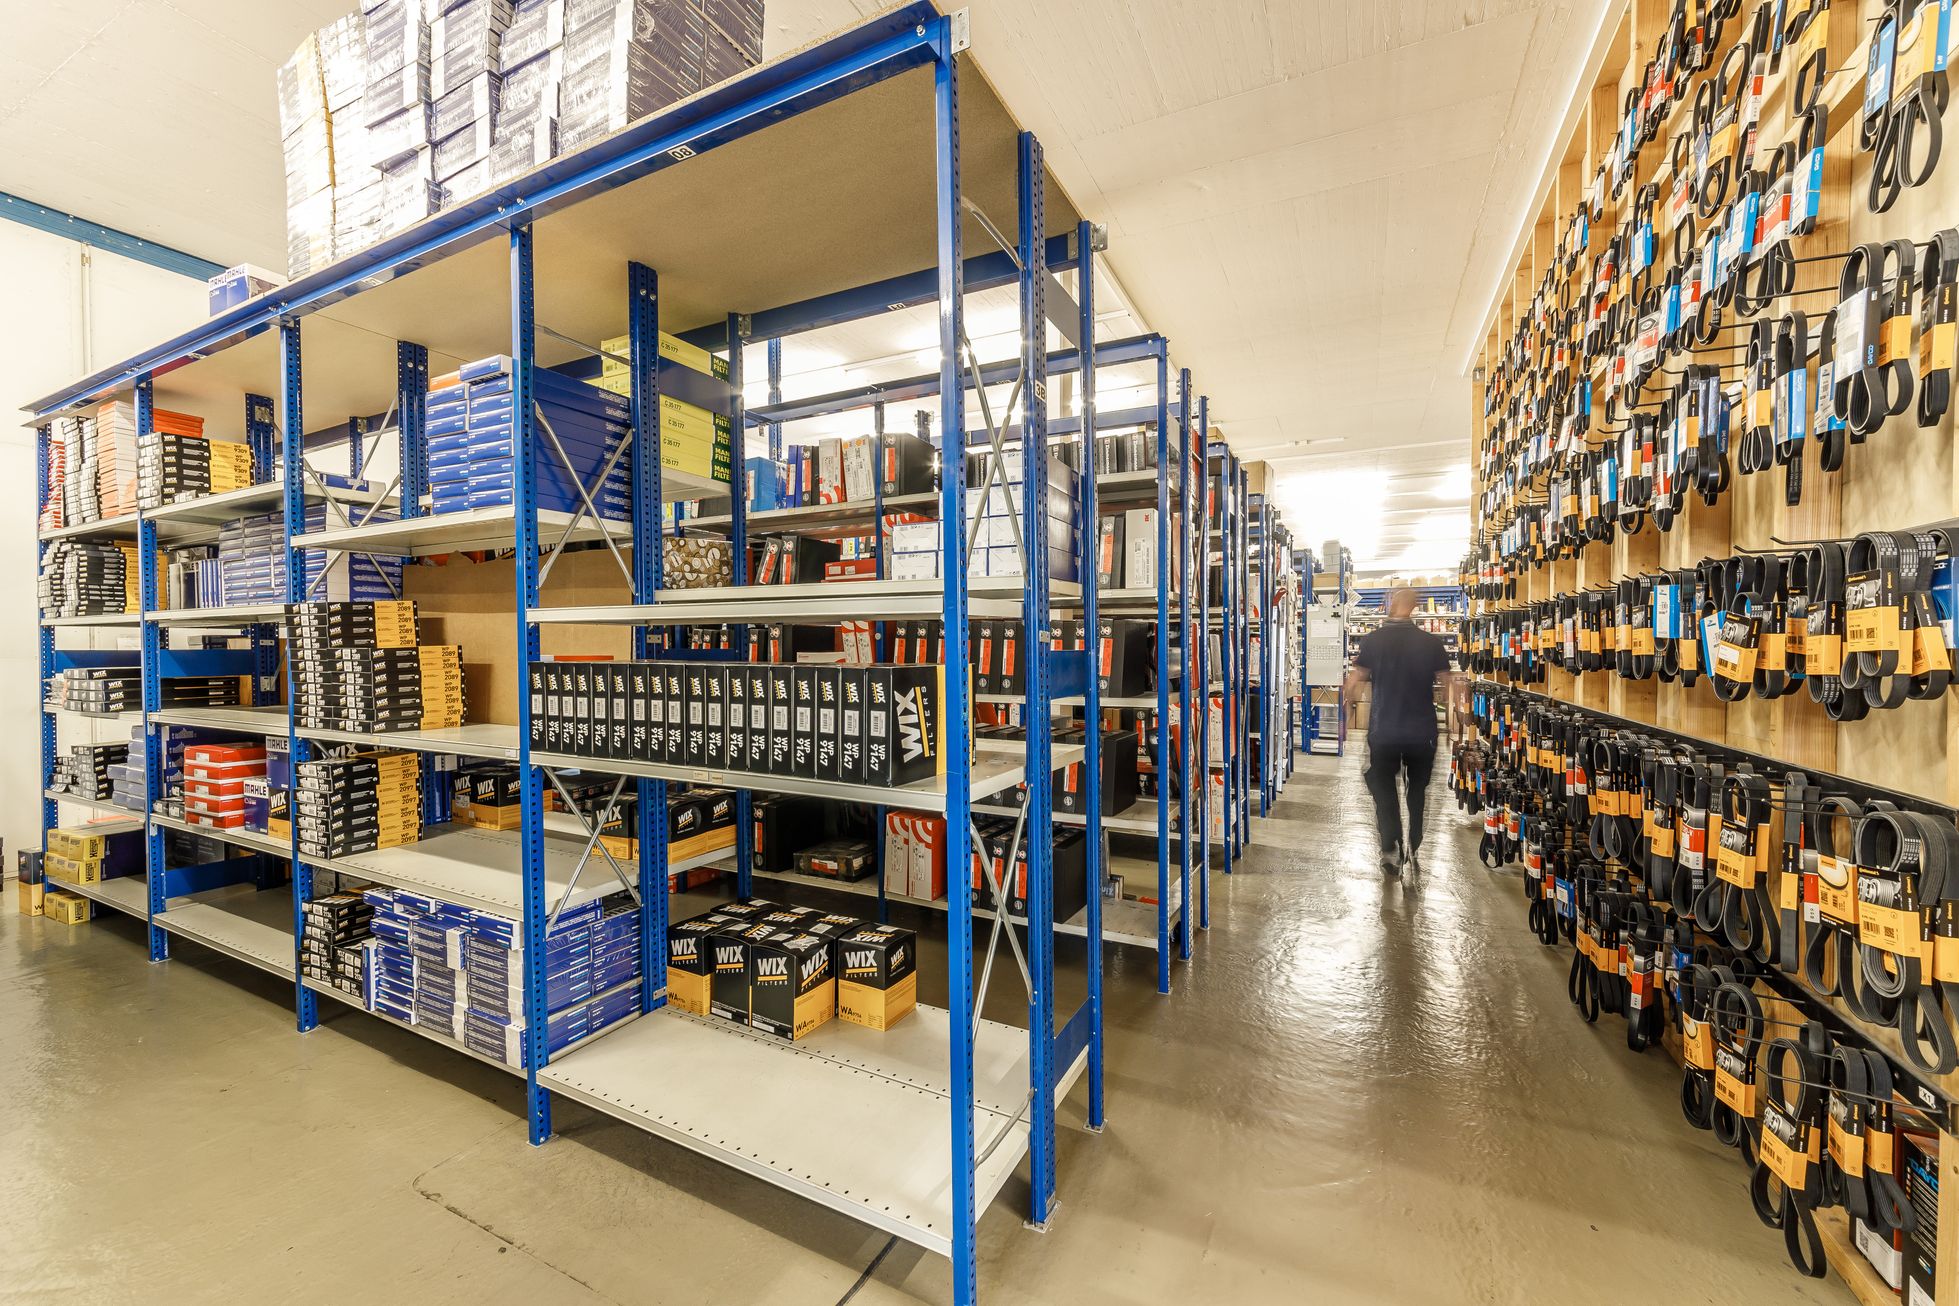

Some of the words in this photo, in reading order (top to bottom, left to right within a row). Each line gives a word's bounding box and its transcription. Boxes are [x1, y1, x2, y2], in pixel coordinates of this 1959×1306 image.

[672, 148, 692, 158] 08
[694, 678, 702, 695] WIX
[712, 678, 721, 696] WIX
[735, 679, 743, 697] WIX
[756, 680, 764, 698] WIX
[778, 680, 787, 699] WIX
[801, 681, 810, 700] WIX
[824, 682, 834, 701] WIX
[849, 683, 859, 703] WIX
[875, 683, 886, 703] WIX
[894, 687, 923, 763] WIX
[921, 686, 935, 756] FILTERS
[657, 728, 663, 741] WP
[675, 730, 681, 743] WP
[696, 731, 702, 744] WP
[715, 733, 721, 746] WP
[737, 734, 743, 748] WP
[758, 736, 765, 750] WP
[267, 739, 288, 750] MAHLE
[774, 737, 782, 762] 9147
[781, 737, 788, 751] WP
[804, 739, 810, 753] WP
[827, 741, 834, 756] WP
[852, 744, 859, 758] WP
[878, 745, 885, 760] WP
[820, 740, 828, 766] 9147
[844, 743, 852, 769] 9147
[870, 744, 879, 771] 9147
[244, 784, 267, 796] MAHLE
[454, 775, 471, 791] WIX
[477, 779, 494, 795] WIX
[270, 791, 286, 808] WIX
[713, 800, 728, 814] WIX
[678, 809, 693, 823] WIX
[748, 925, 777, 941] WIX
[850, 934, 887, 943] WIX
[671, 938, 697, 955] WIX
[716, 946, 744, 963] WIX
[801, 944, 828, 980] WIX
[845, 950, 877, 968] WIX
[890, 946, 904, 965] WIX
[758, 957, 787, 975] WIX
